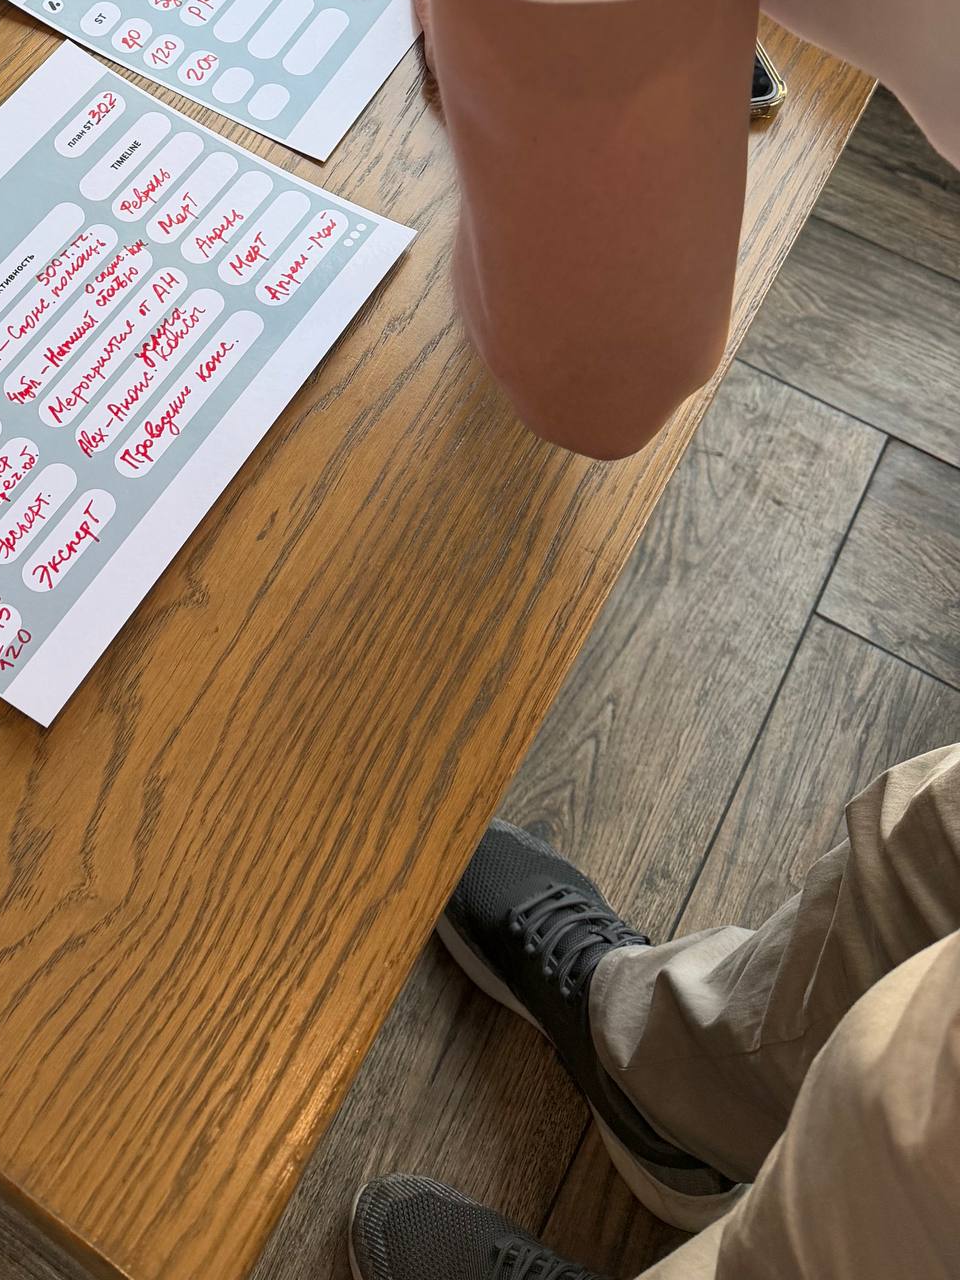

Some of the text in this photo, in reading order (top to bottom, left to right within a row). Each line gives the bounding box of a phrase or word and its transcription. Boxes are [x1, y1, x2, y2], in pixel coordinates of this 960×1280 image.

[95, 13, 107, 24] ST
[151, 40, 177, 65] 120
[67, 93, 117, 148] план ST 302
[111, 140, 142, 171] TIMELINE
